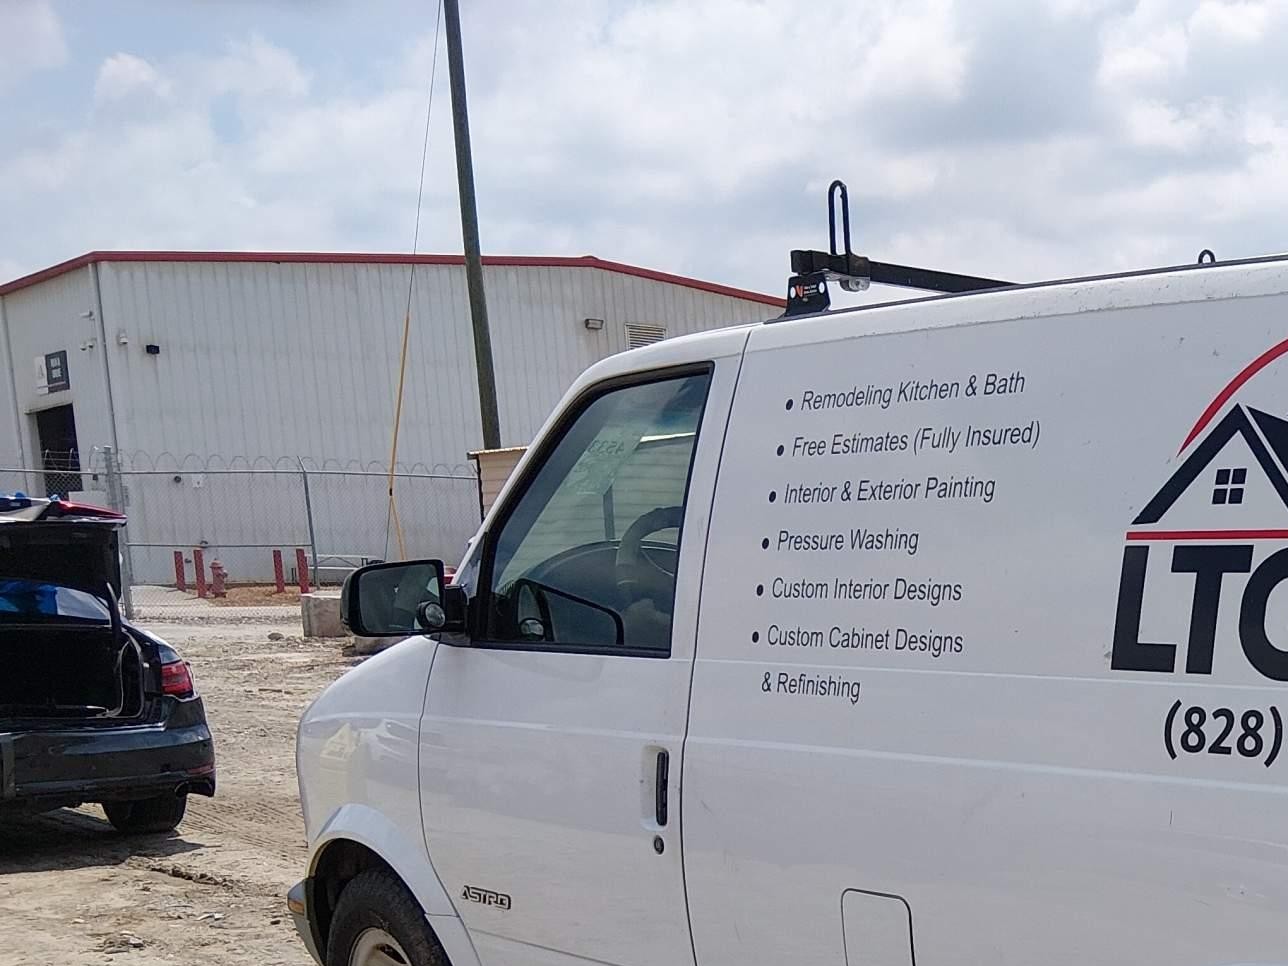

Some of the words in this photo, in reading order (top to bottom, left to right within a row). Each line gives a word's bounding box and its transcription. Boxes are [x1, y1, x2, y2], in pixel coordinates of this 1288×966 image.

[800, 385, 893, 411] Remodeling
[896, 381, 960, 403] Kitchen
[964, 374, 978, 397] &
[983, 371, 1025, 396] Bath
[792, 436, 827, 457] Free
[830, 431, 909, 456] Estimates
[913, 427, 962, 456] (Fully
[965, 420, 1040, 449] Insured)
[784, 483, 838, 504] Interior
[840, 480, 852, 502] &
[857, 479, 921, 502] Exterior
[924, 476, 996, 504] Painting
[777, 530, 844, 552] Pressure
[850, 528, 919, 556] Washing
[772, 576, 829, 600] Custom
[833, 578, 890, 601] Interior
[894, 578, 963, 607] Designs
[767, 624, 824, 648] Custom
[829, 627, 890, 651] Cabinet
[894, 628, 963, 658] Designs
[761, 671, 772, 693] &
[776, 672, 861, 705] Refinishing
[1163, 698, 1283, 768] (828)
[462, 884, 511, 911] ASTRO
